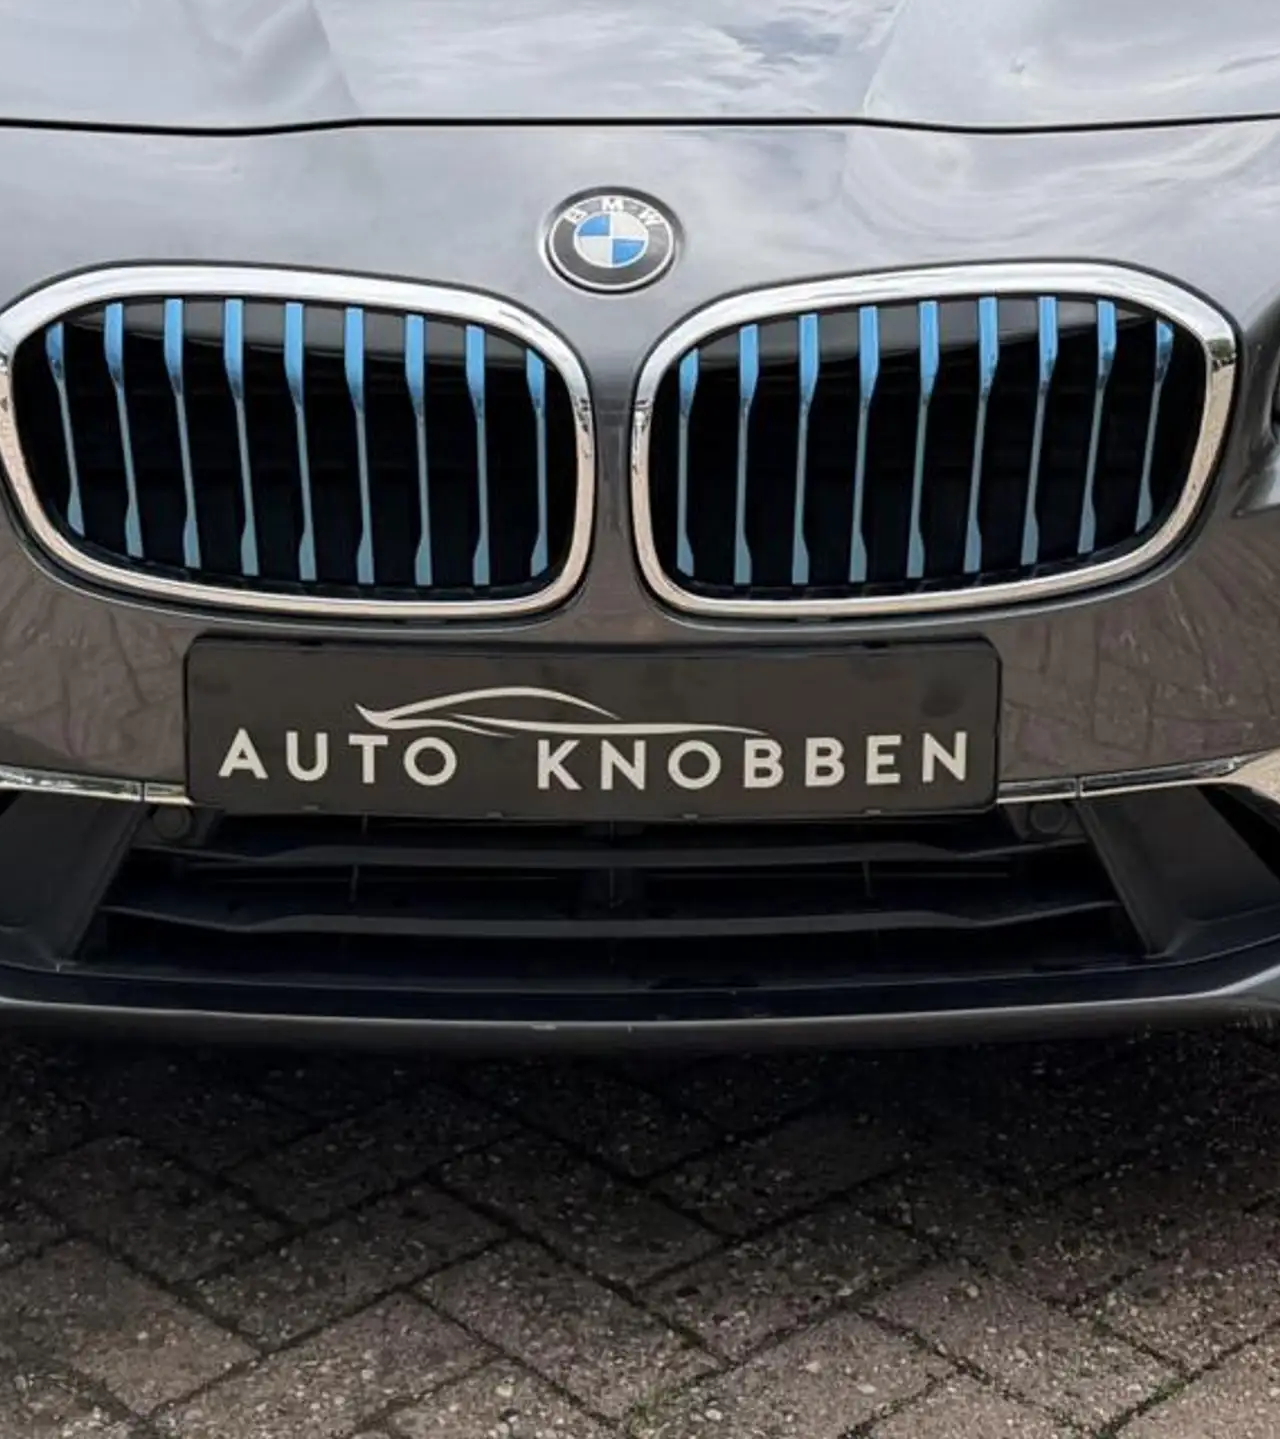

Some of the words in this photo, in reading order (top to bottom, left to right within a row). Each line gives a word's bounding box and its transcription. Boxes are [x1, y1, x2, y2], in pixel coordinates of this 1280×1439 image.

[564, 196, 665, 226] BMW
[218, 729, 458, 787] AUTO
[537, 731, 968, 791] KNOBBEN
